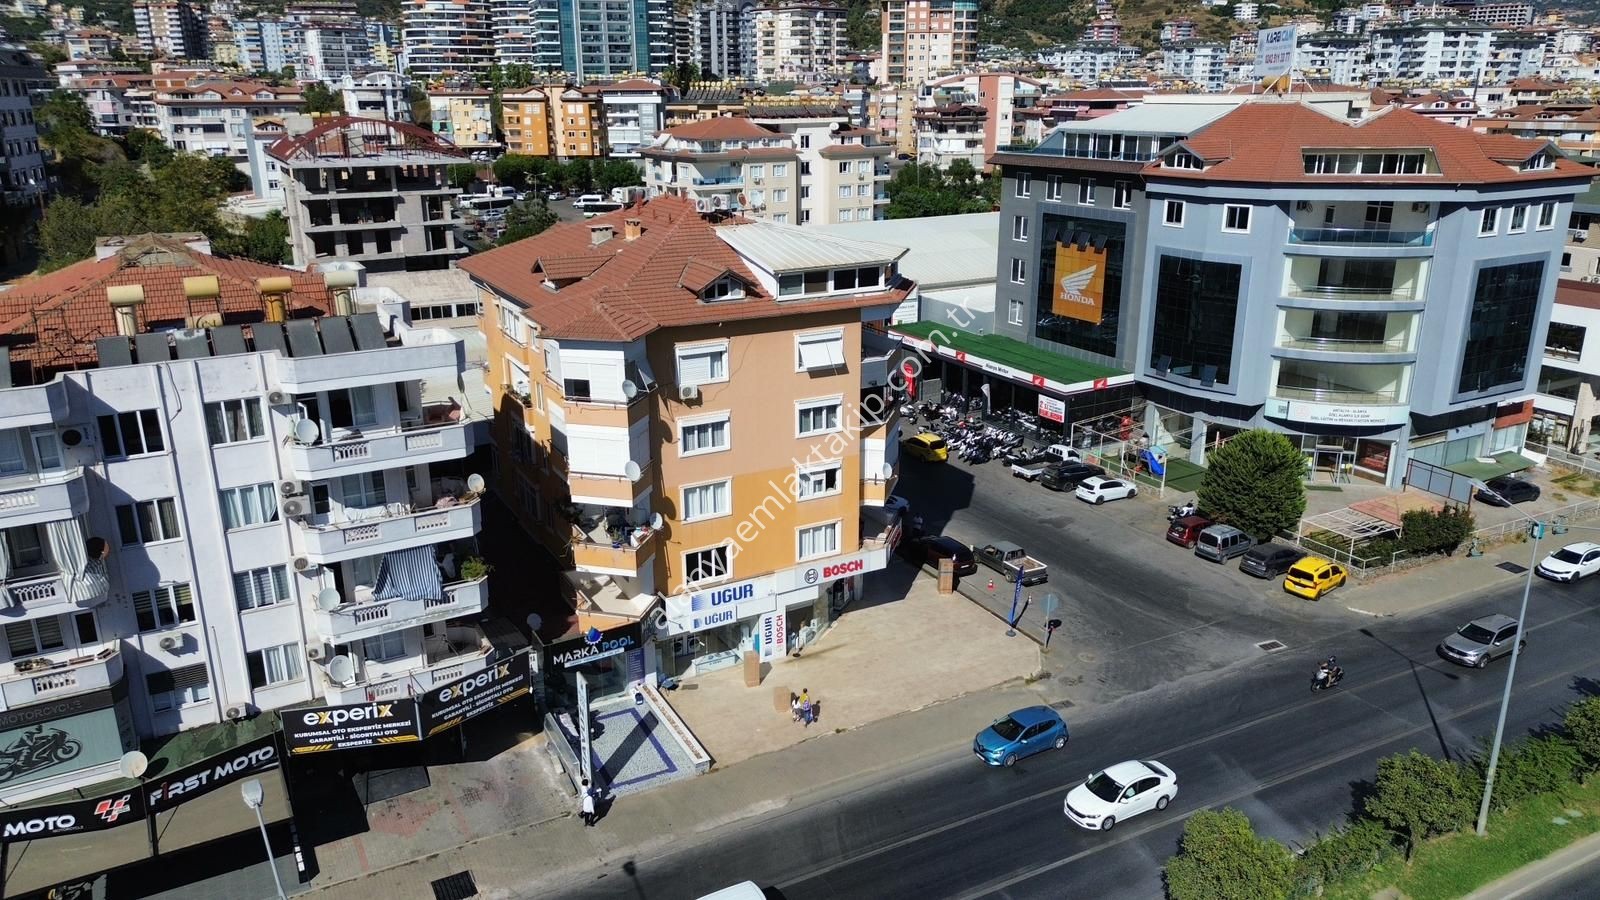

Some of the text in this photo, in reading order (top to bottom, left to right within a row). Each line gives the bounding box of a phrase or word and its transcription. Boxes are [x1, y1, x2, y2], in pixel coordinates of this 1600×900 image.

[1060, 292, 1095, 305] HONDA
[823, 559, 863, 578] BOSCH
[776, 614, 784, 644] BOSCH
[553, 645, 599, 665] MARKA
[602, 636, 634, 651] POOL
[439, 663, 510, 702] experix
[502, 686, 514, 694] OTO
[431, 704, 461, 718] KURUMSAL
[474, 684, 501, 700] EKSPERTİZ
[0, 700, 83, 727] MOTORCYCLE
[303, 703, 393, 726] experix
[294, 730, 330, 738] KURUMSAL
[347, 724, 382, 733] EKSPERTİZ
[382, 720, 411, 729] MERKEZİ
[309, 733, 345, 744] GARANTİLİ
[349, 731, 383, 739] SİGORTALI
[338, 738, 373, 748] EKSPERTİZ
[213, 745, 274, 781] MOTO
[3, 814, 76, 837] MOTO
